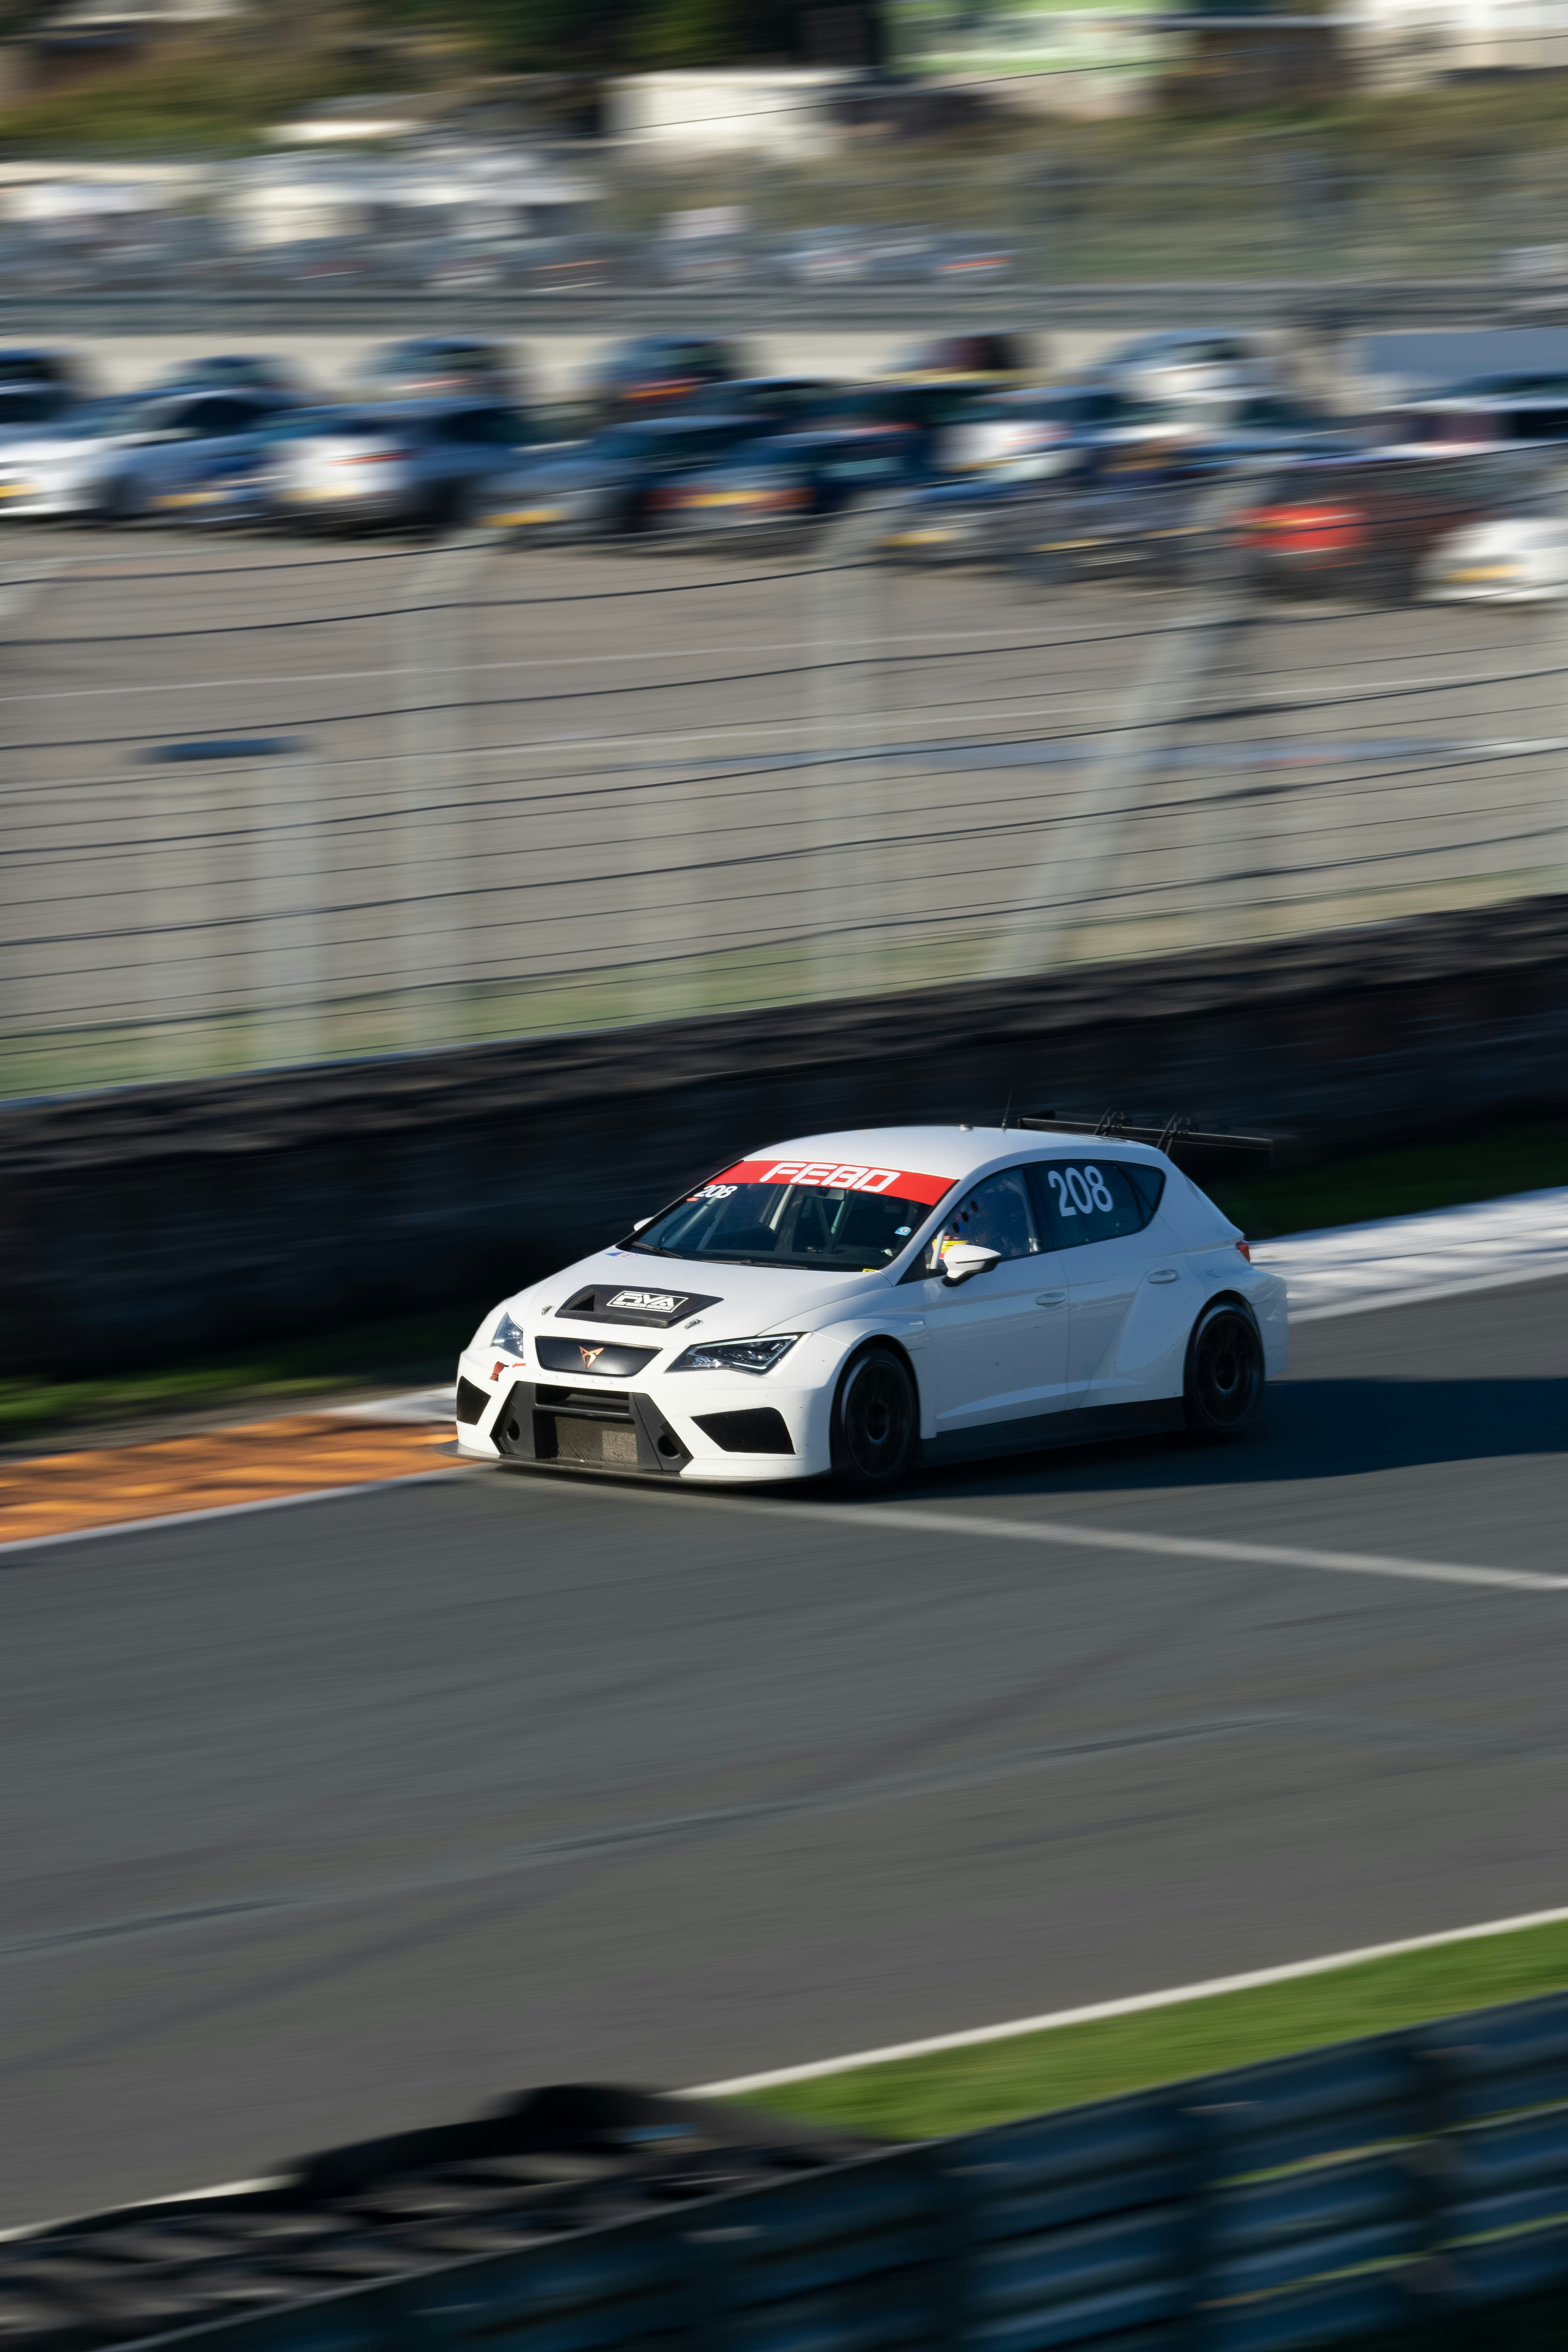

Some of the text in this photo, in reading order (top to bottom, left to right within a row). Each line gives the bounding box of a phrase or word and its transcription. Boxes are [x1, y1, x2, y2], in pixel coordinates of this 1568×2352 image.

[693, 1184, 738, 1198] 208
[759, 1162, 901, 1192] FEBO
[1047, 1166, 1114, 1217] 208
